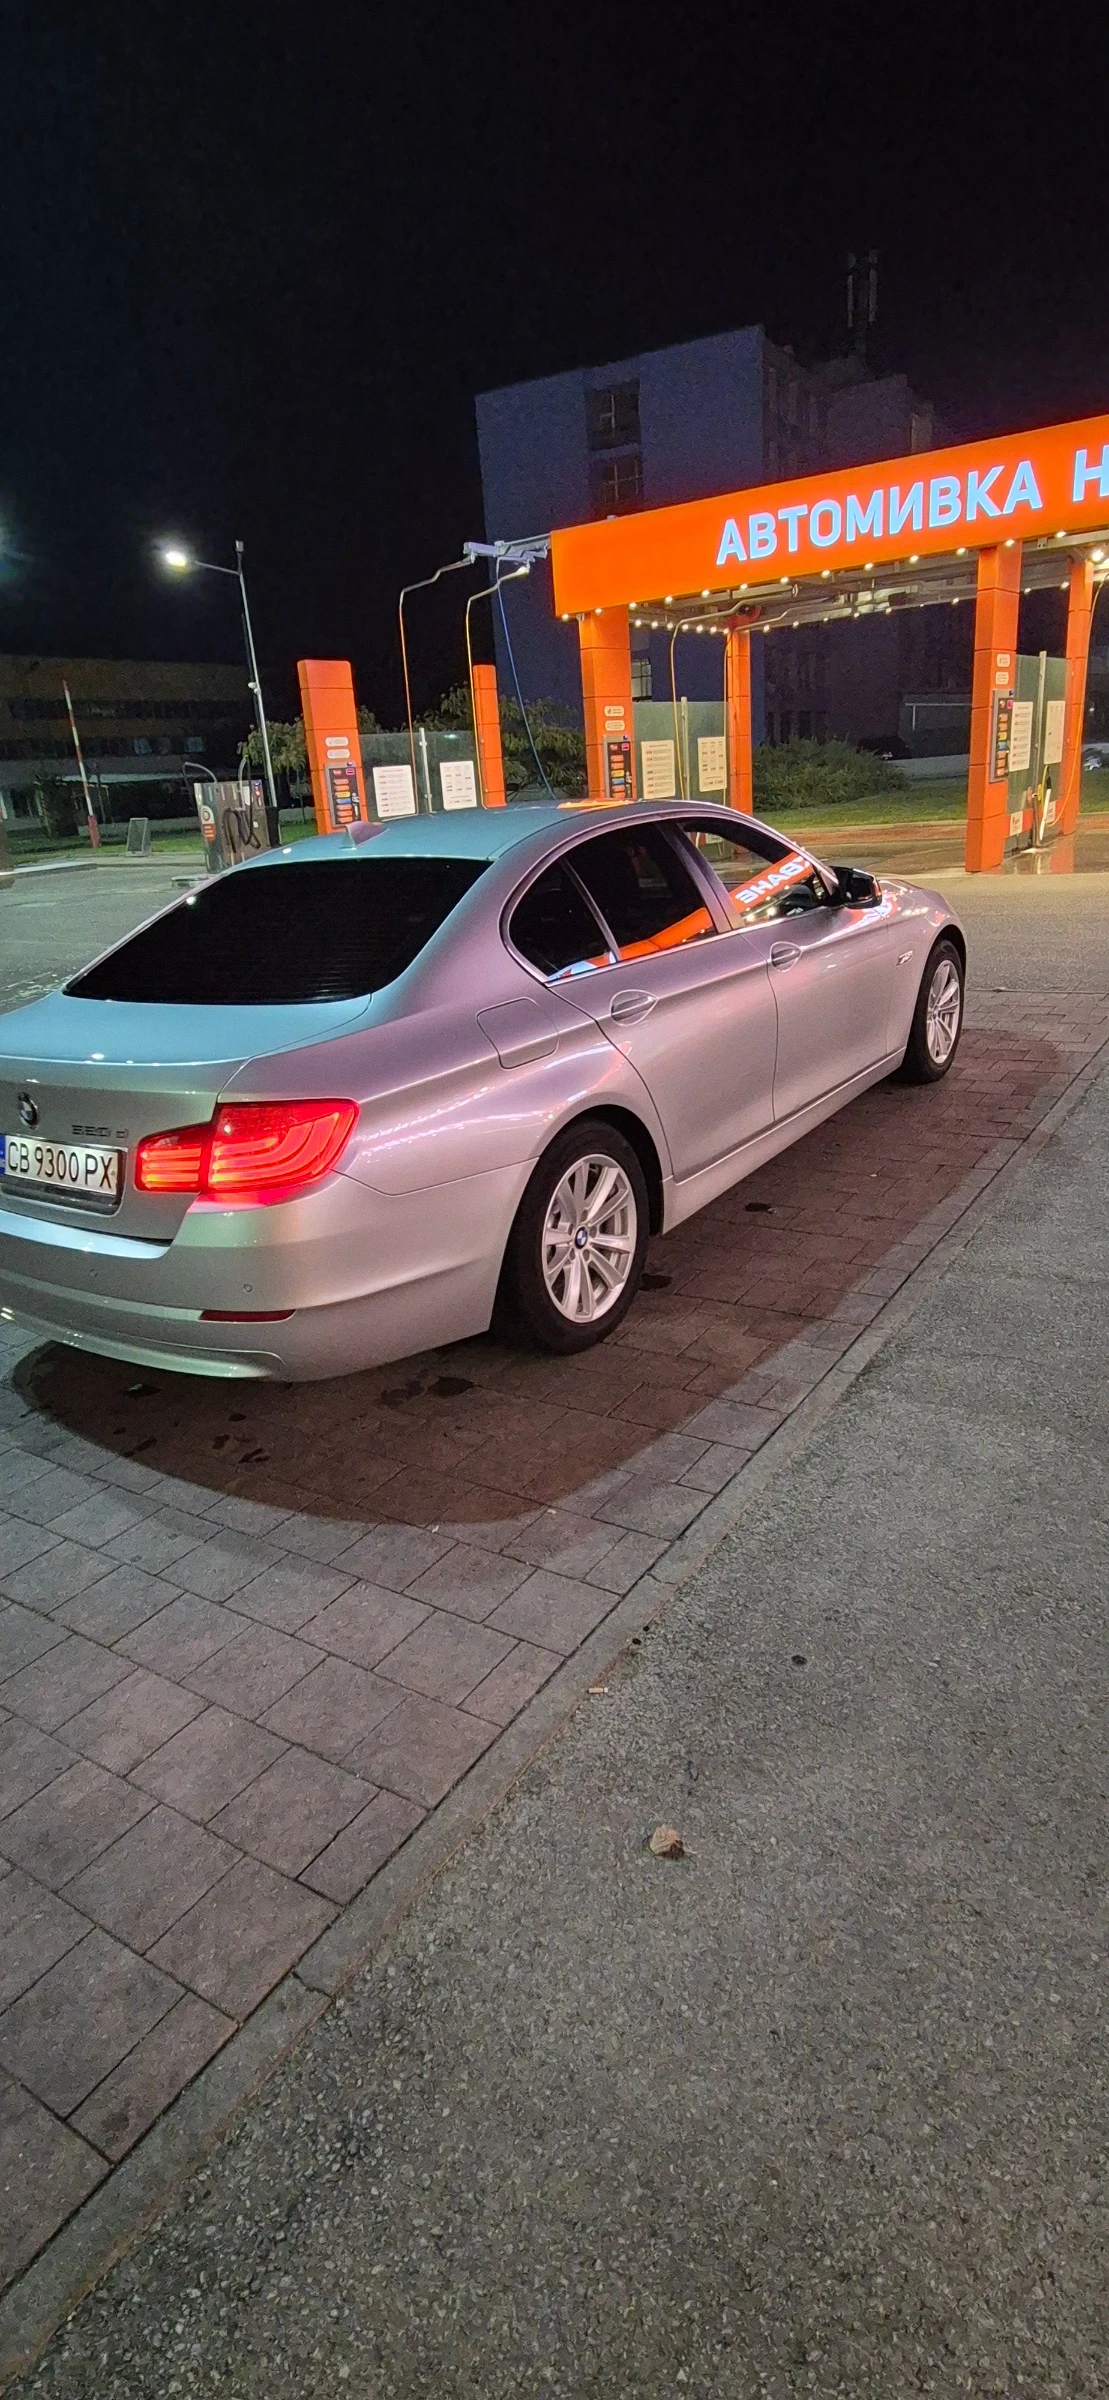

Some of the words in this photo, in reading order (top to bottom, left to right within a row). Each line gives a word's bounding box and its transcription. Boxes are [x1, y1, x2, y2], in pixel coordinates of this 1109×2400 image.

[716, 460, 1043, 566] АВТОМИВКА
[1072, 444, 1109, 502] Н
[7, 1141, 30, 1173] CB
[34, 1144, 80, 1182] 9300
[84, 1152, 113, 1189] PX
